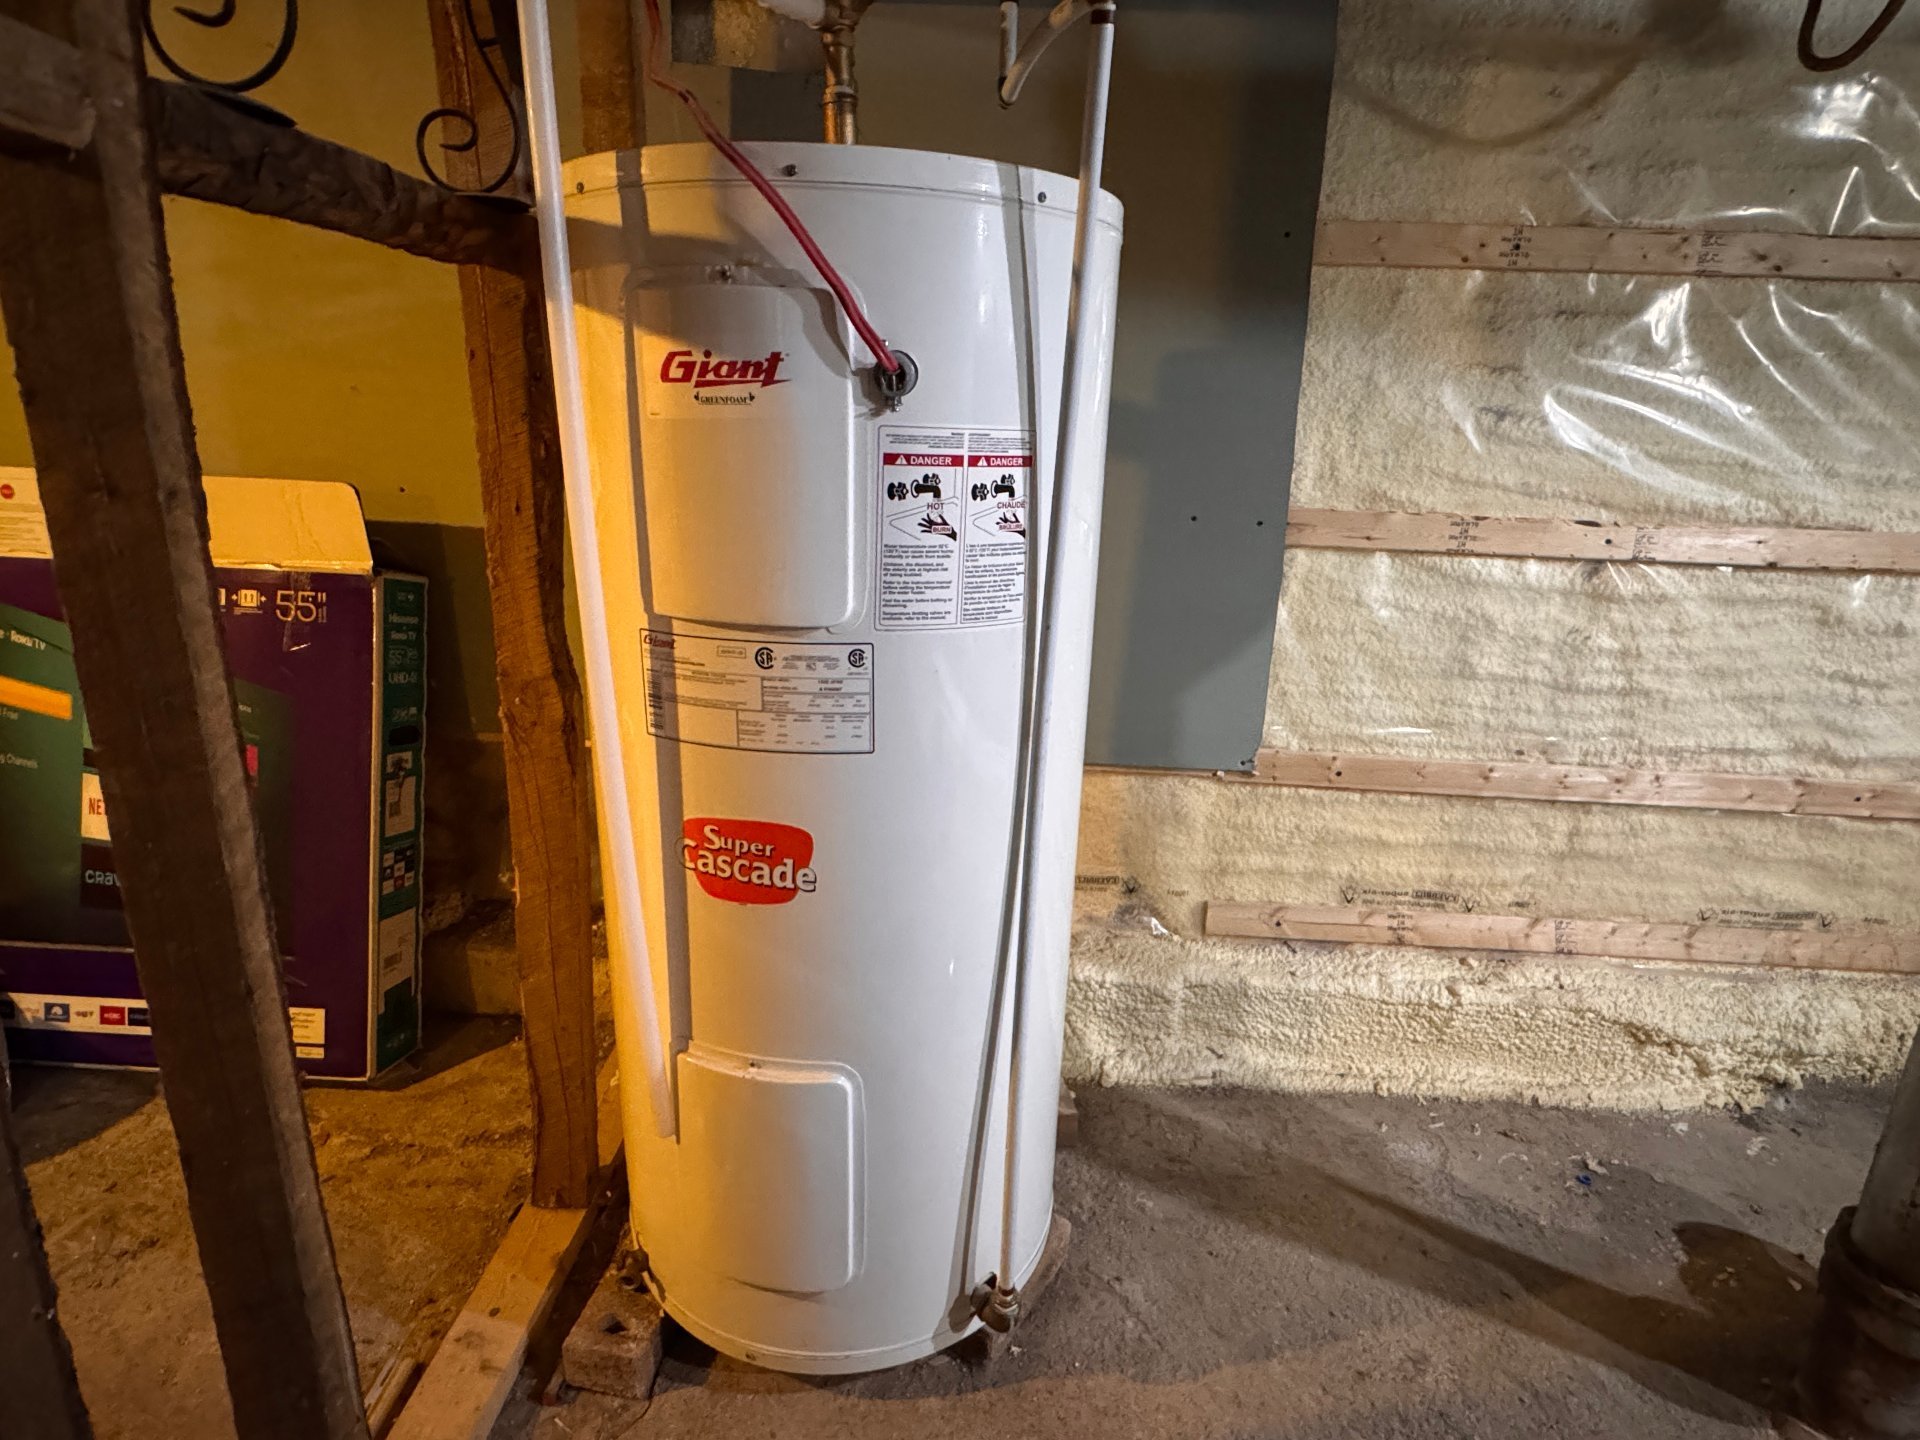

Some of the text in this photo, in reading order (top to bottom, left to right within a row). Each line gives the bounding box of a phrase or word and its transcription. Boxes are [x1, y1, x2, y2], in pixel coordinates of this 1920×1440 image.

[660, 350, 789, 388] Giant
[910, 456, 952, 466] DANGER
[990, 457, 1023, 466] DANGER
[927, 502, 945, 510] HOT
[996, 501, 1026, 509] CHAUDE
[703, 825, 775, 857] Super
[674, 836, 817, 893] Cascade
